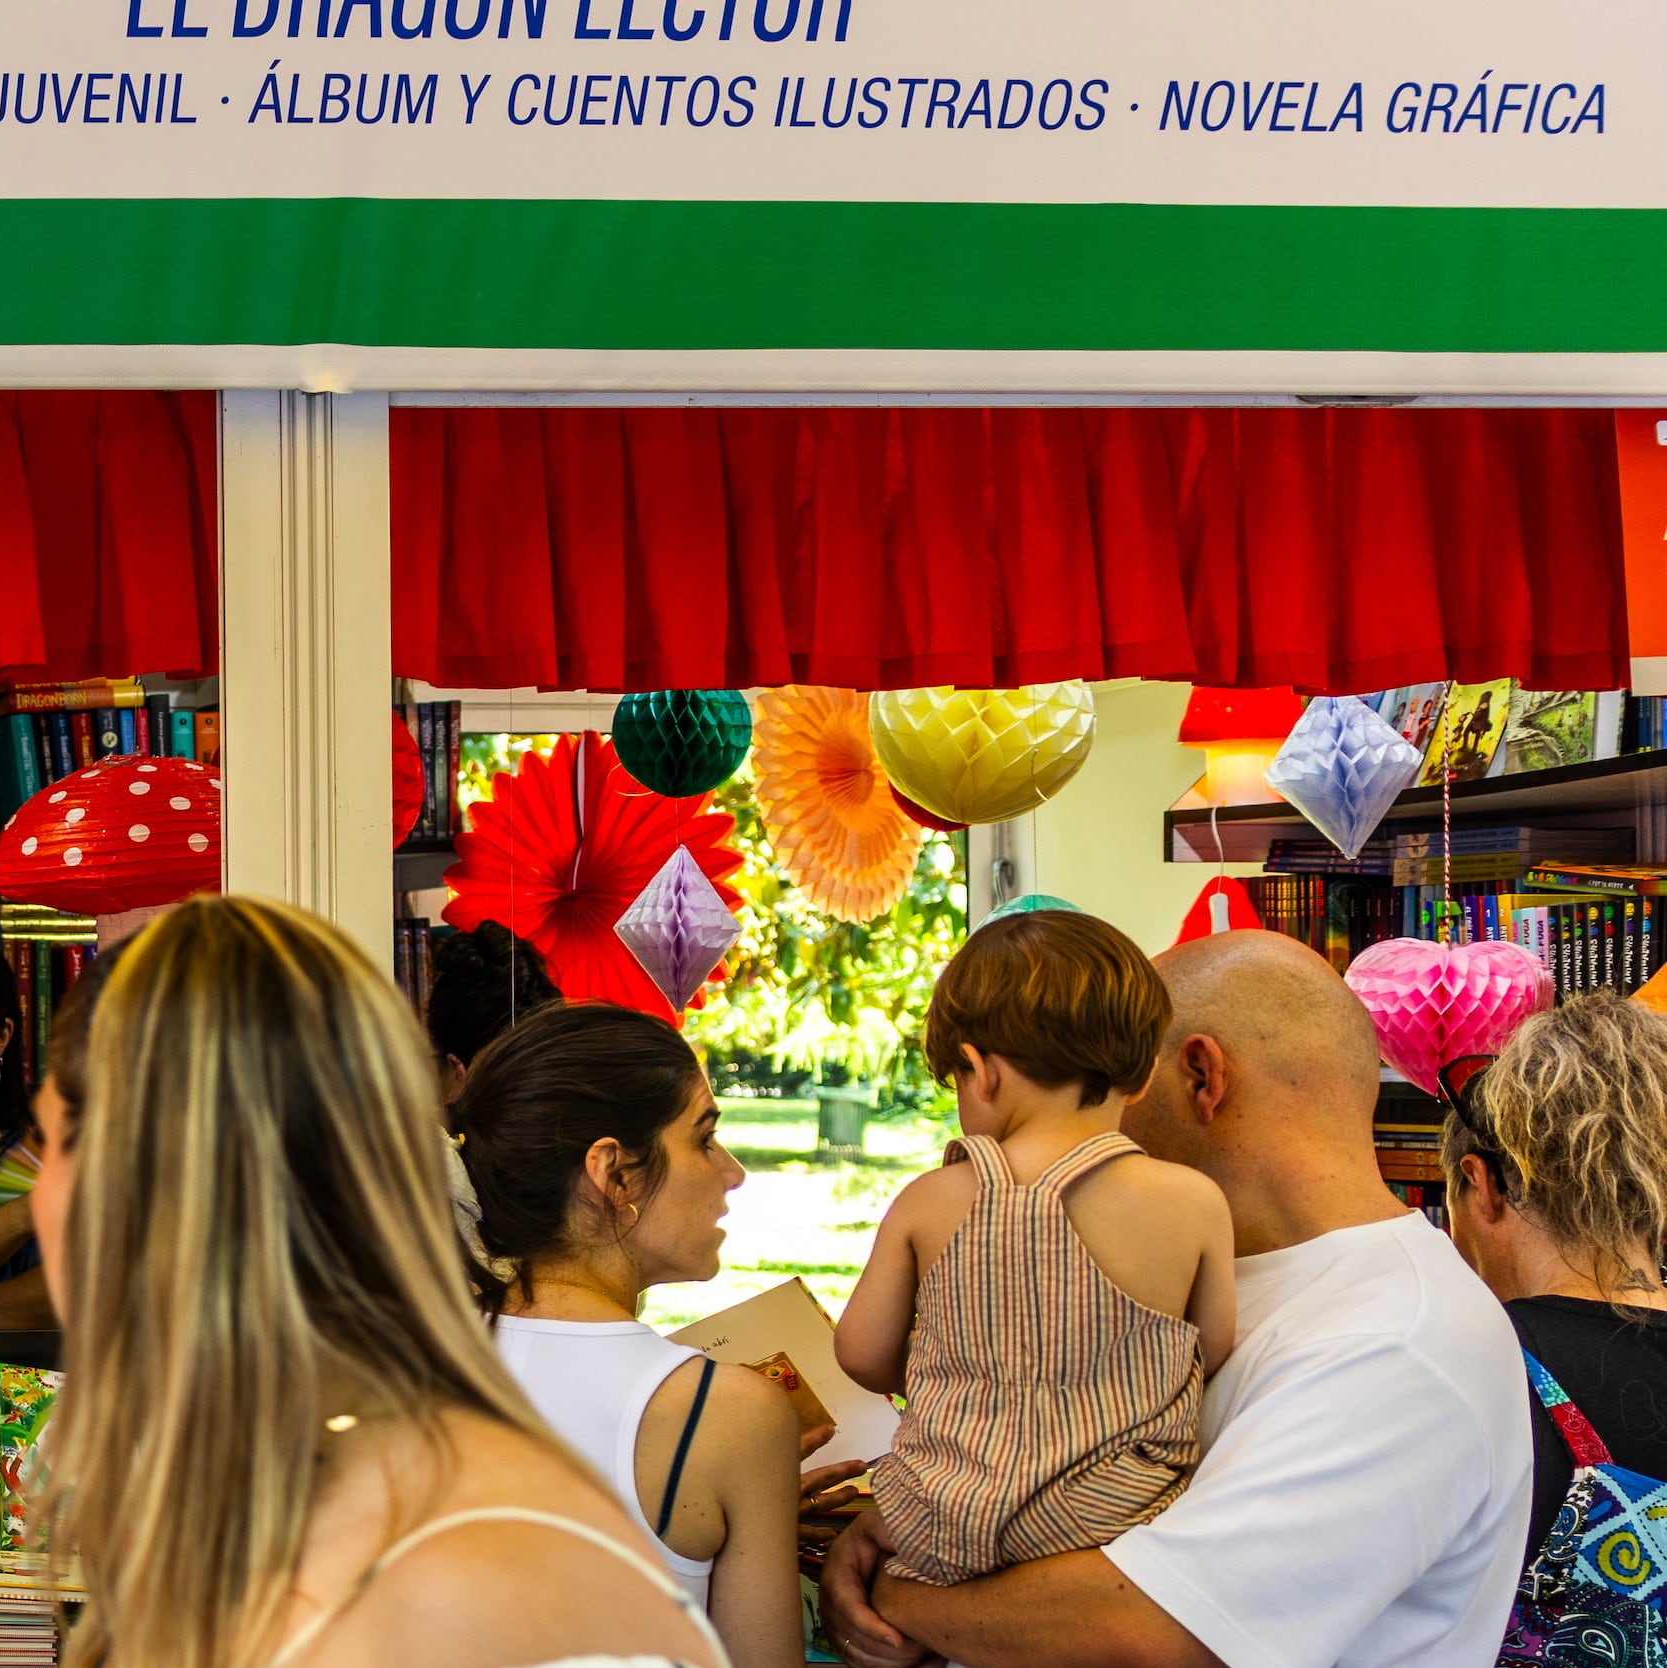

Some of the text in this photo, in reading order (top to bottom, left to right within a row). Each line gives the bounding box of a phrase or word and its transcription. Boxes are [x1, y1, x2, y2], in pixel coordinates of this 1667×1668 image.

[247, 60, 439, 125] ÁLBUM
[460, 73, 492, 125] Y
[506, 74, 757, 128] CUENTOS
[774, 76, 1109, 131] ILUSTRADOS
[1158, 80, 1365, 133] NOVELA
[1384, 70, 1609, 135] GRÁFICA
[16, 692, 88, 709] DRAGONBORN
